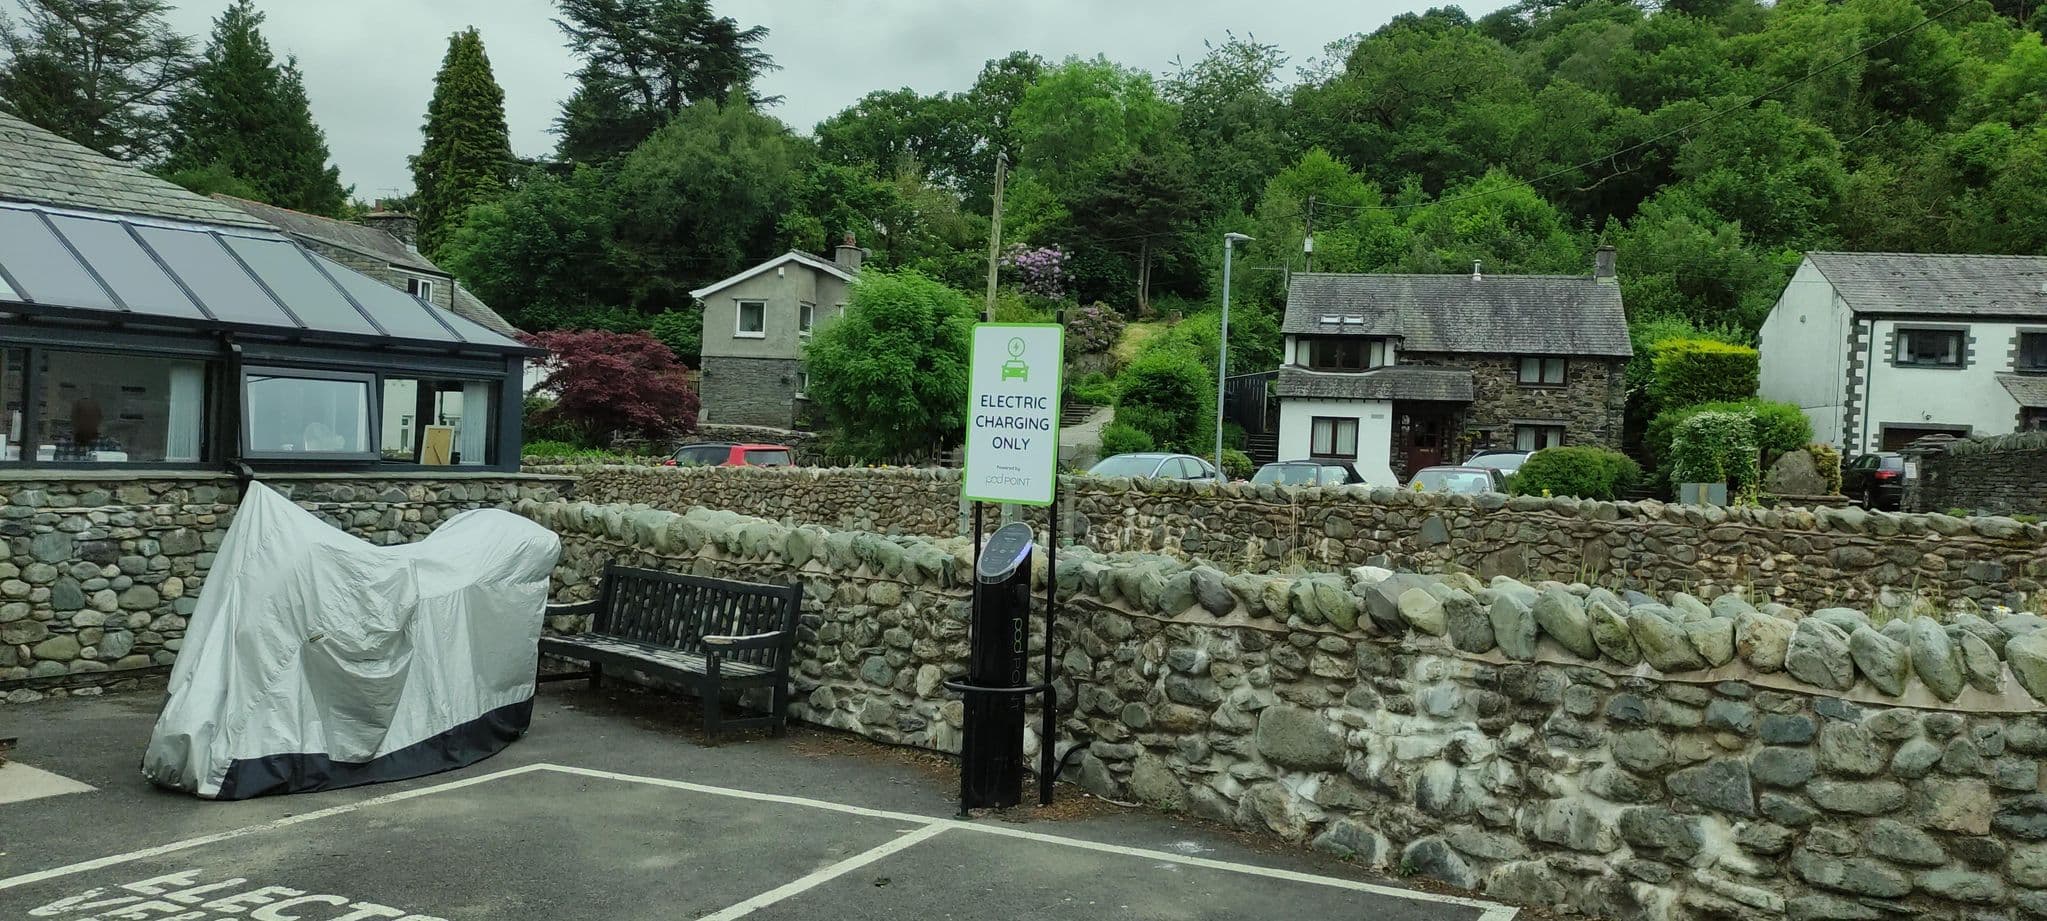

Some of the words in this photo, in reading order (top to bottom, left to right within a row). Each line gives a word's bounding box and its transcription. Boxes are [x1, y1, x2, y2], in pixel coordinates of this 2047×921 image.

[980, 394, 1048, 410] ELECTRIC
[975, 415, 1050, 431] CHARGING
[992, 436, 1031, 451] ONLY
